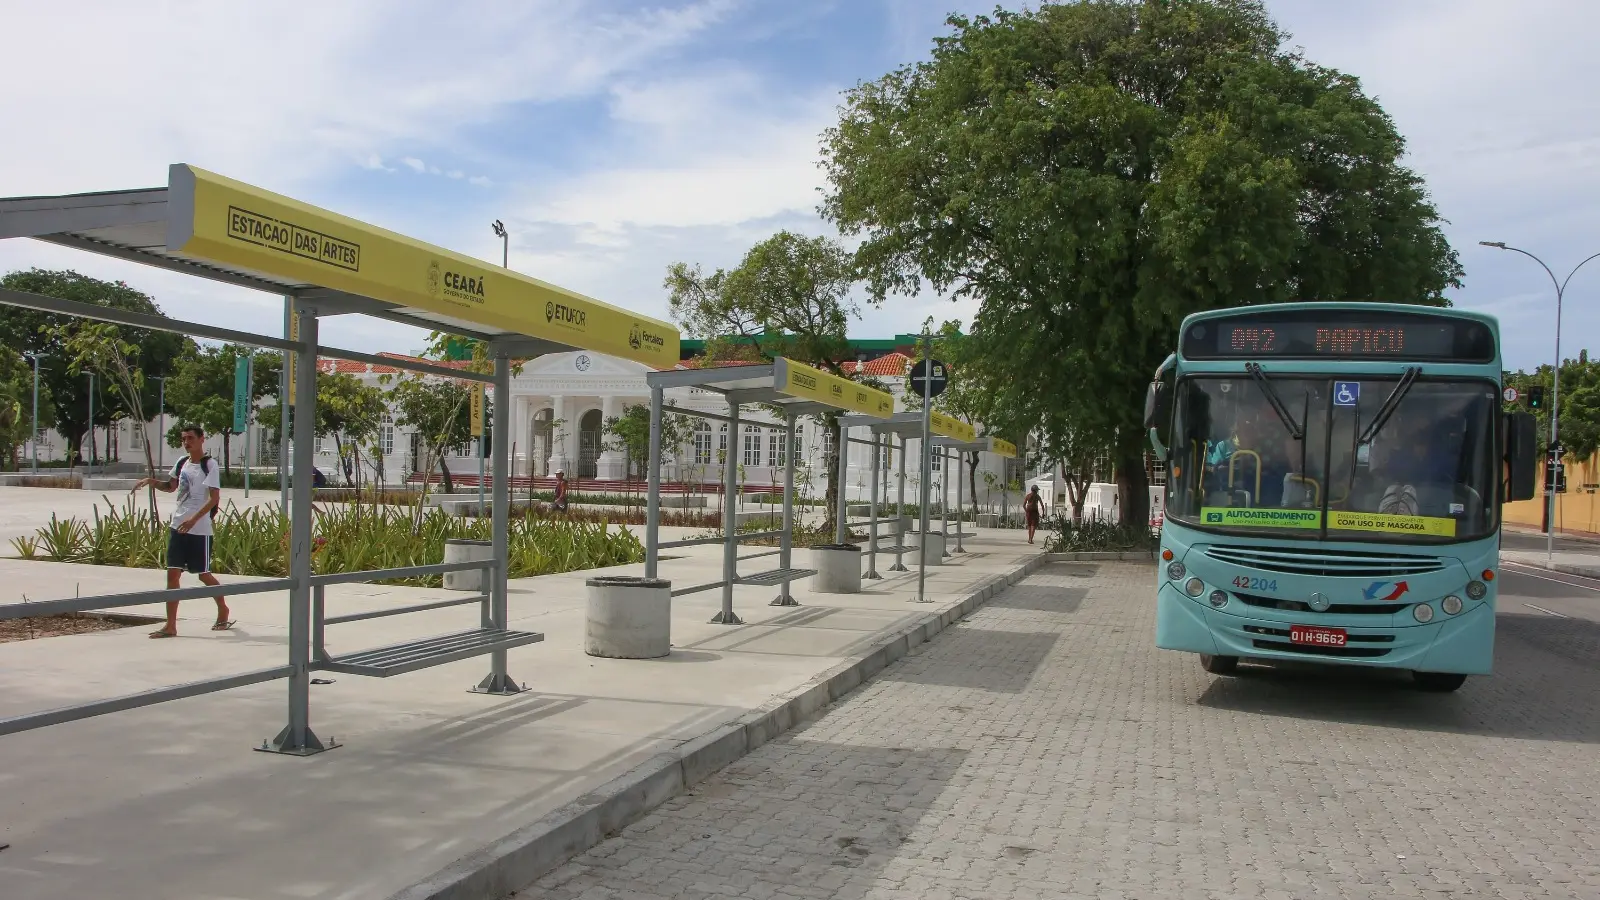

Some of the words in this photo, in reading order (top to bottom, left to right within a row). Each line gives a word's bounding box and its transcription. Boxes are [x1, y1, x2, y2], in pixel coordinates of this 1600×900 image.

[295, 232, 317, 254] DAS
[322, 241, 356, 265] ARTES
[444, 271, 484, 297] CEARÁ
[555, 304, 586, 326] ETUFOR
[642, 330, 664, 346] Fortaleza
[1231, 329, 1275, 351] 042
[1316, 329, 1403, 352] PAPICU
[1225, 510, 1316, 521] AUTOATENDIMENTO
[1232, 576, 1278, 592] 42204
